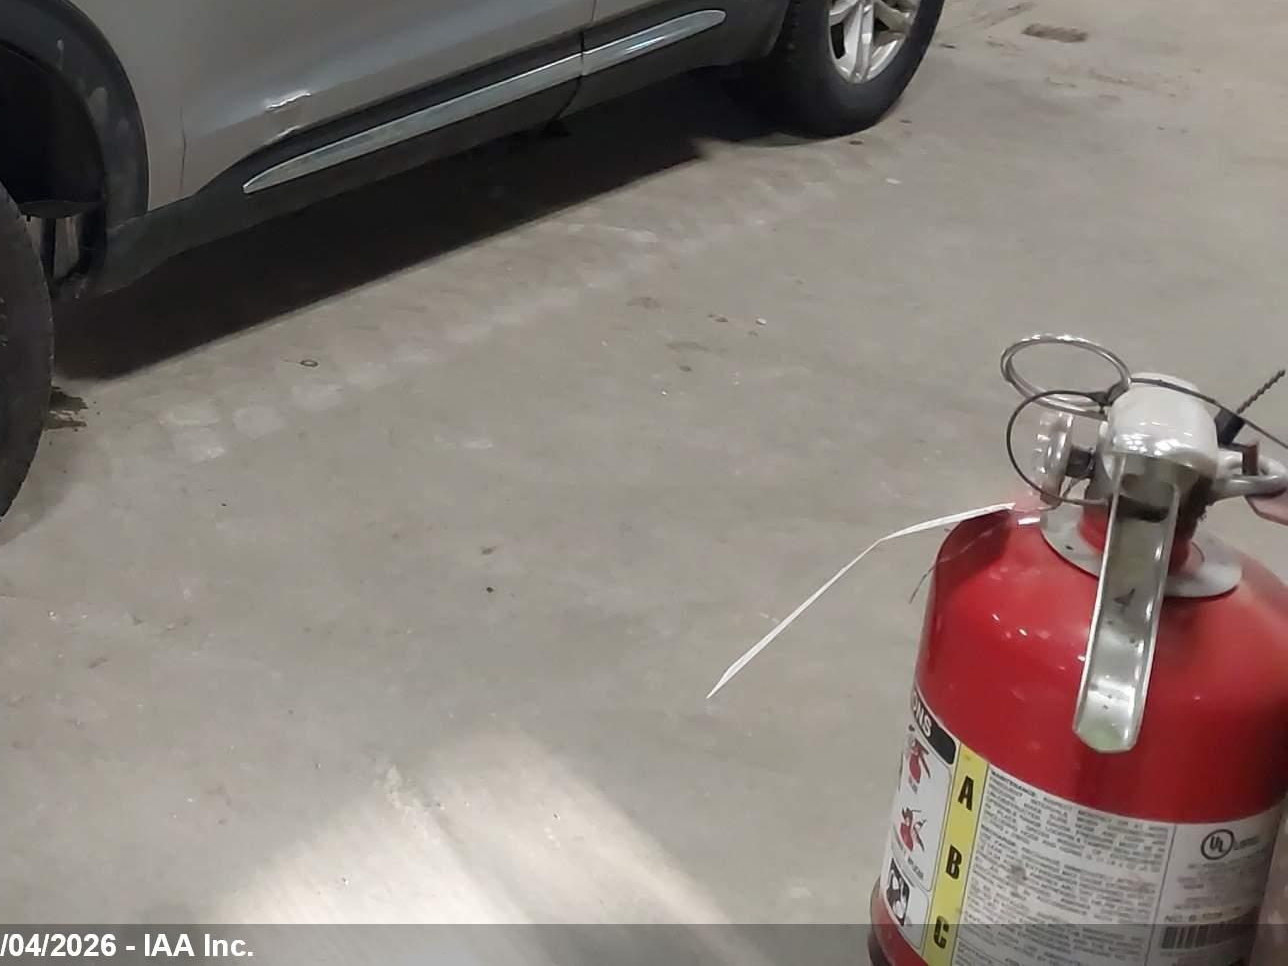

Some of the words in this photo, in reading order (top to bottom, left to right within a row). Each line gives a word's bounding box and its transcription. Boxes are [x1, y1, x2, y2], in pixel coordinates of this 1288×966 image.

[957, 776, 974, 811] A
[946, 845, 963, 880] B
[933, 915, 950, 949] C
